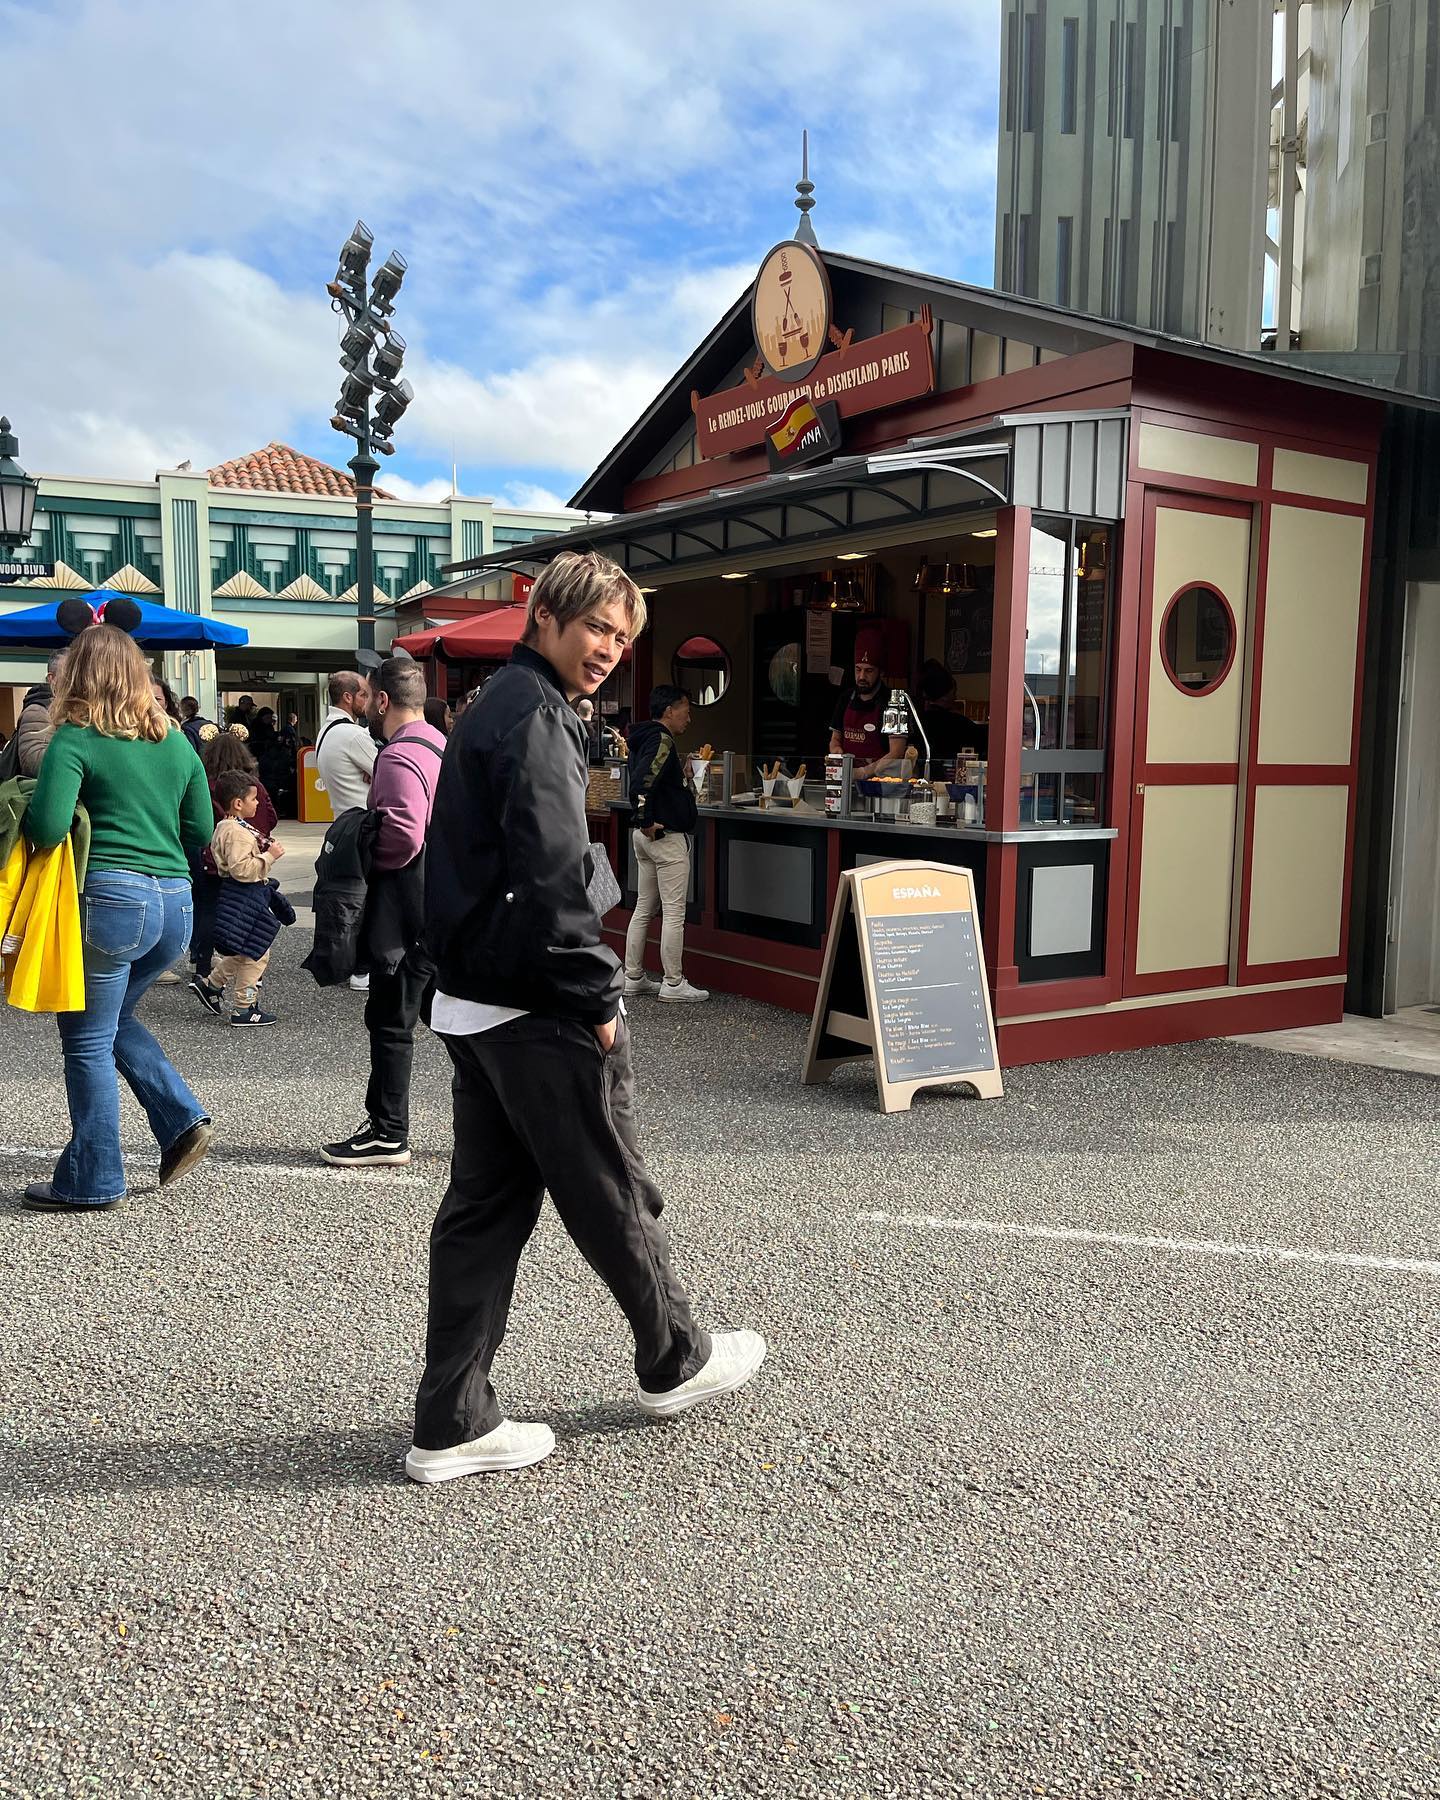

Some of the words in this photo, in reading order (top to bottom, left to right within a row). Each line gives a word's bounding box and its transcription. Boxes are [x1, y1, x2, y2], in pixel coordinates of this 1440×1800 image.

[708, 417, 717, 433] Le
[718, 401, 766, 430] RENDEZ-VOUS
[814, 381, 826, 399] de
[827, 362, 880, 395] DISNEYLAND
[881, 350, 910, 377] PARIS
[23, 564, 48, 575] BLVD.
[892, 885, 941, 899] ESPAÑA
